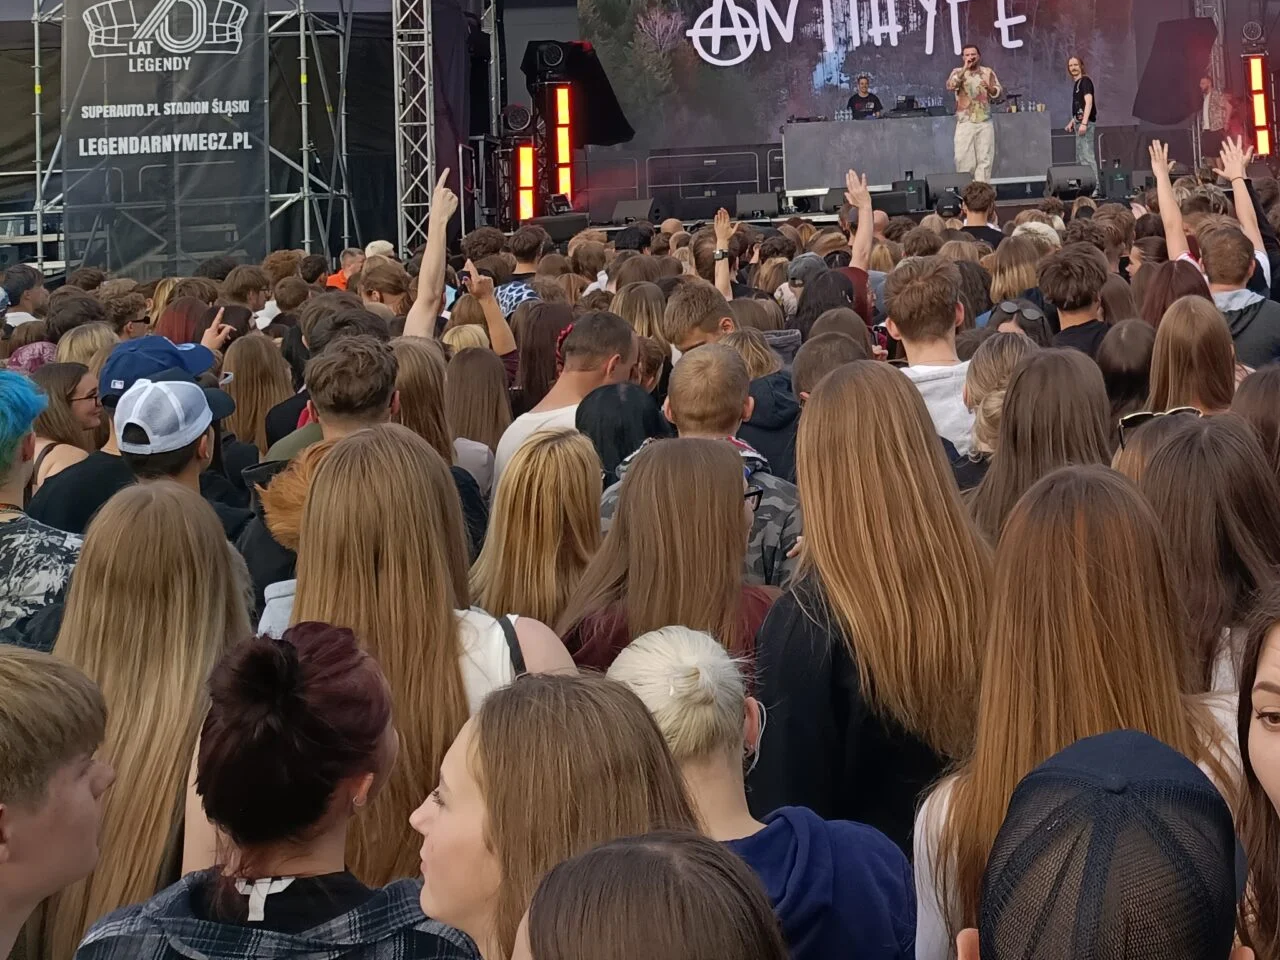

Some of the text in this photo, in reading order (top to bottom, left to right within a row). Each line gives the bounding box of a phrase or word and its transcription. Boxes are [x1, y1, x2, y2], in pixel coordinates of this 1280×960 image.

[129, 41, 153, 55] LAT
[128, 56, 191, 72] LEGENDY
[81, 98, 249, 118] SUPERAUTO.PL STADION ŚLĄSKI
[78, 131, 253, 156] LEGENDARNYMECZ.PL
